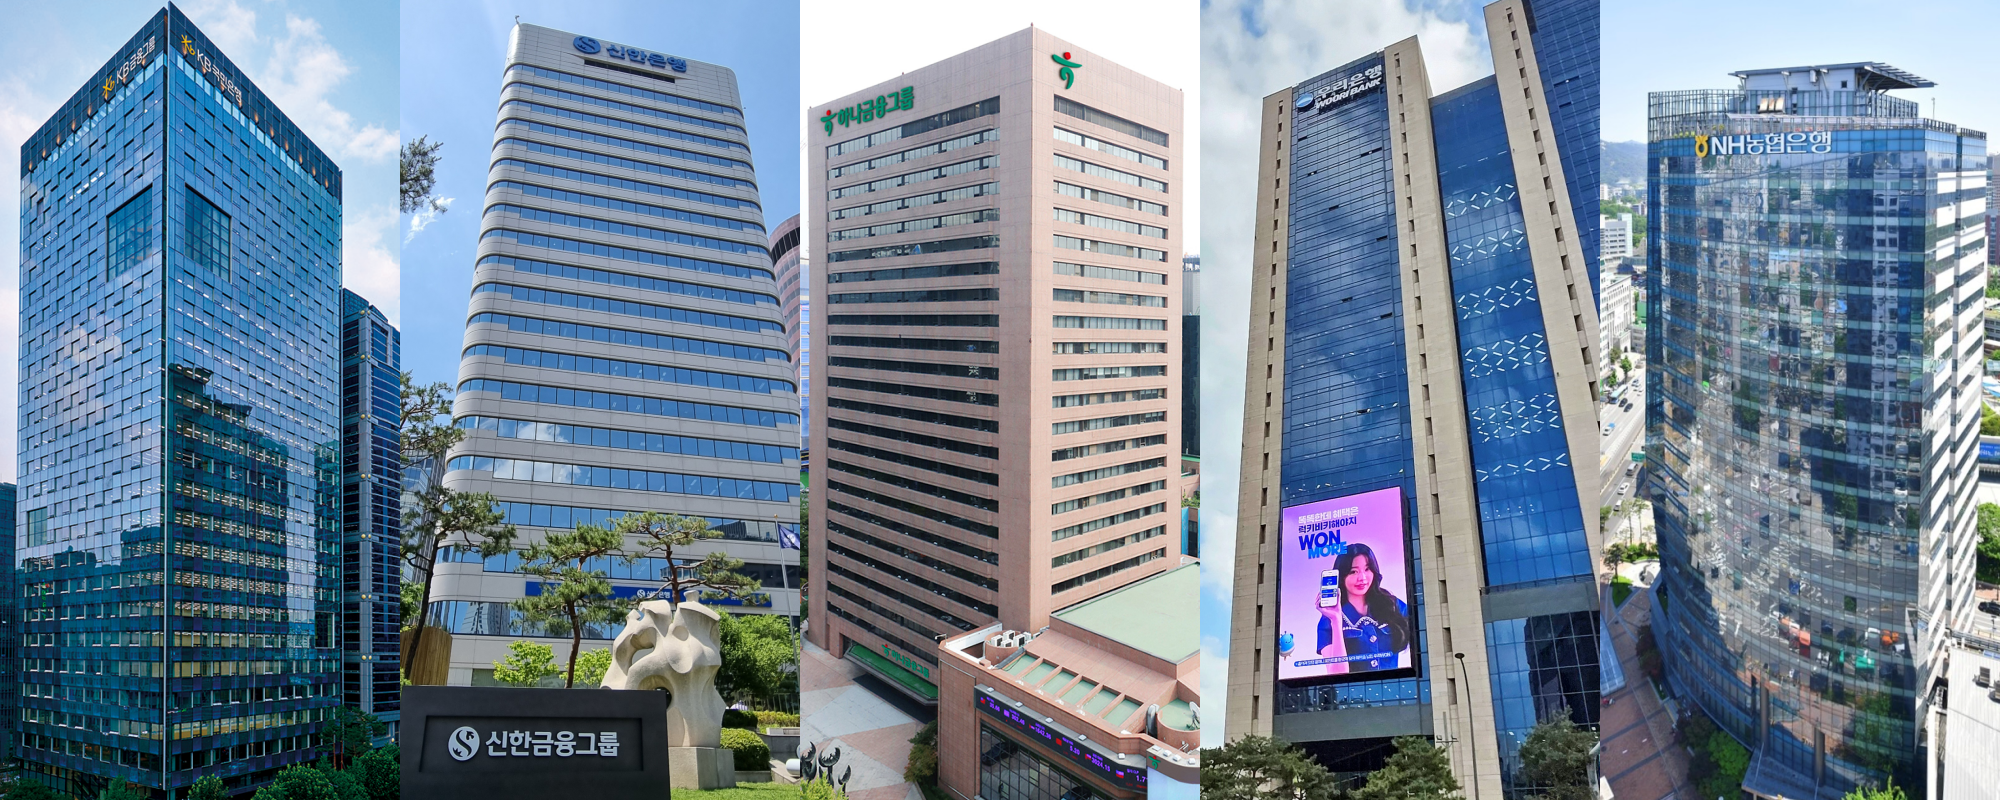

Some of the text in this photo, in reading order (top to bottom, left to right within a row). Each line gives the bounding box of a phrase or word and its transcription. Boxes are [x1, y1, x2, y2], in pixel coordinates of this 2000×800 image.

[116, 35, 156, 84] KB금융그룹
[606, 44, 687, 73] 신한은행
[197, 48, 242, 104] KB국민은행
[1314, 64, 1382, 101] 우리은행
[837, 86, 915, 128] 하나금융그룹
[1315, 77, 1382, 109] WOORI BANK
[1711, 131, 1832, 155] NH농협은행
[1298, 516, 1357, 534] 럭키비키해야지
[1298, 529, 1341, 551] WON
[1308, 541, 1348, 560] MORE
[891, 650, 930, 679] 하나금융그룹
[485, 730, 620, 757] 신한금융그룹
